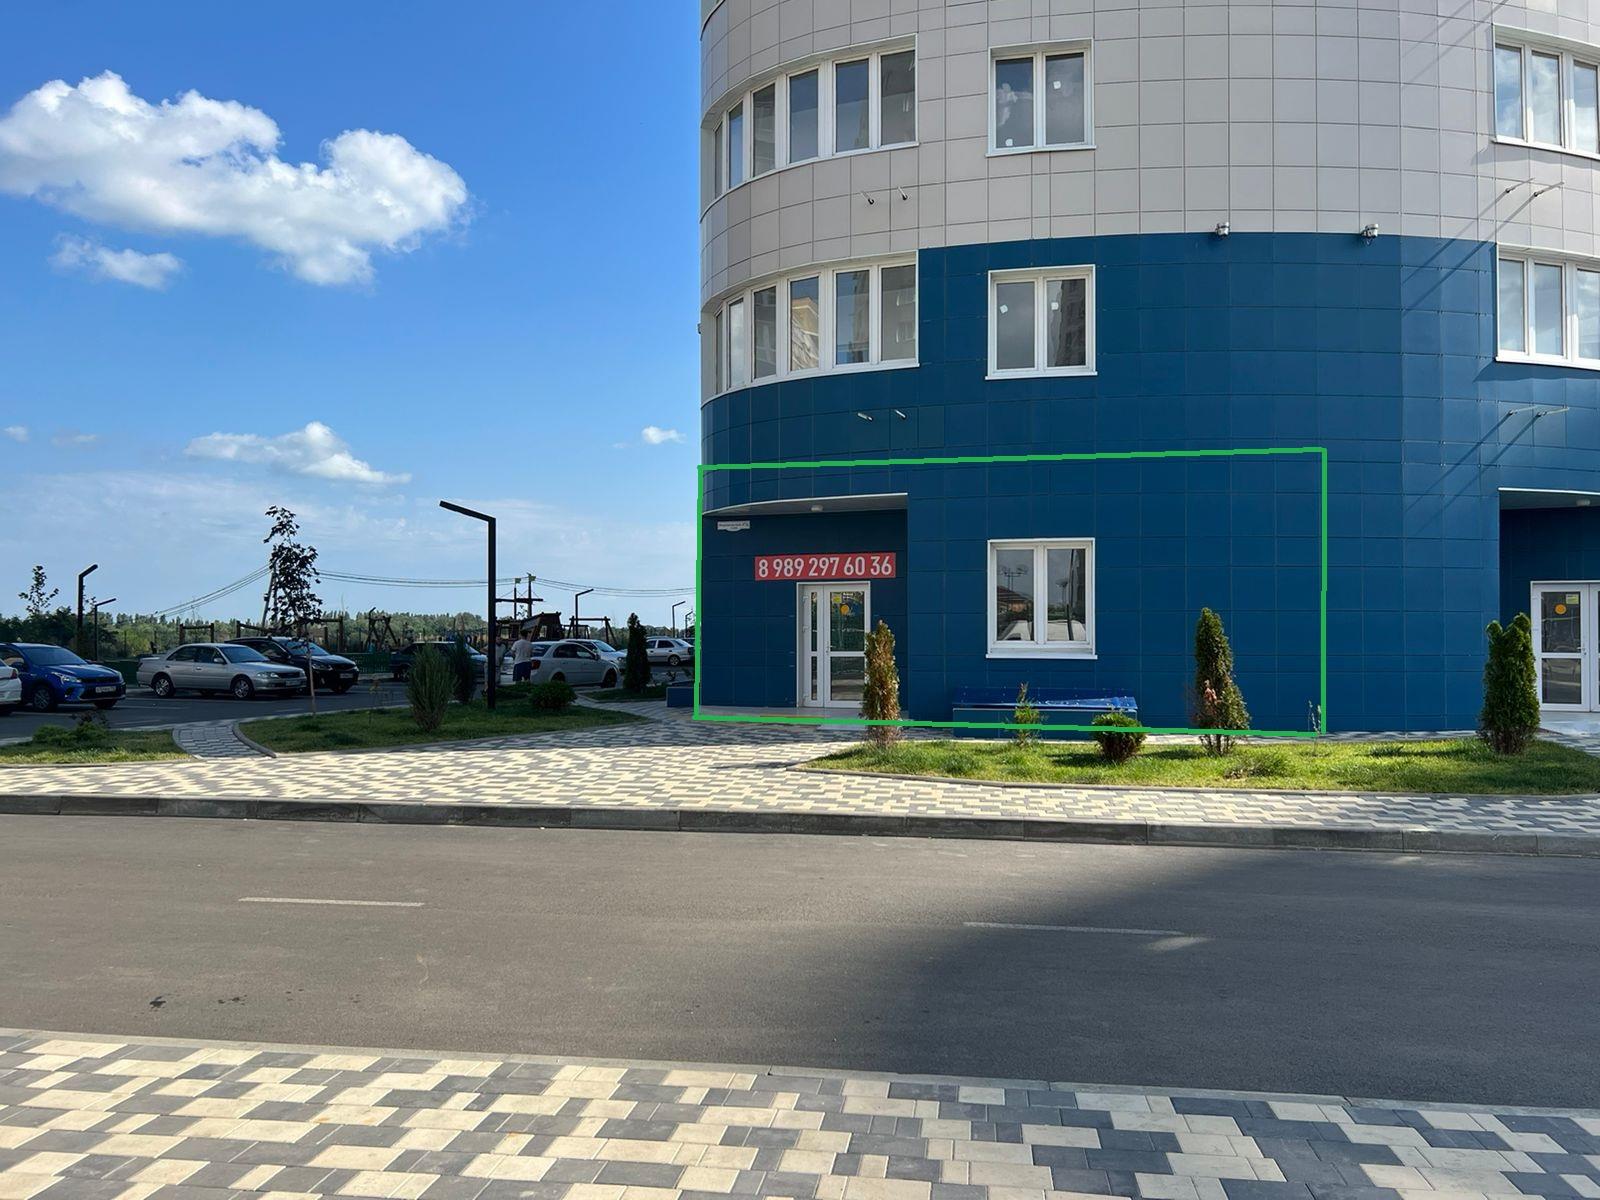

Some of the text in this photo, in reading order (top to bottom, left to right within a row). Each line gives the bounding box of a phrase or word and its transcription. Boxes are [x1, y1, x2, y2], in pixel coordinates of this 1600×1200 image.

[758, 556, 892, 577] 8 989 297 60 36
